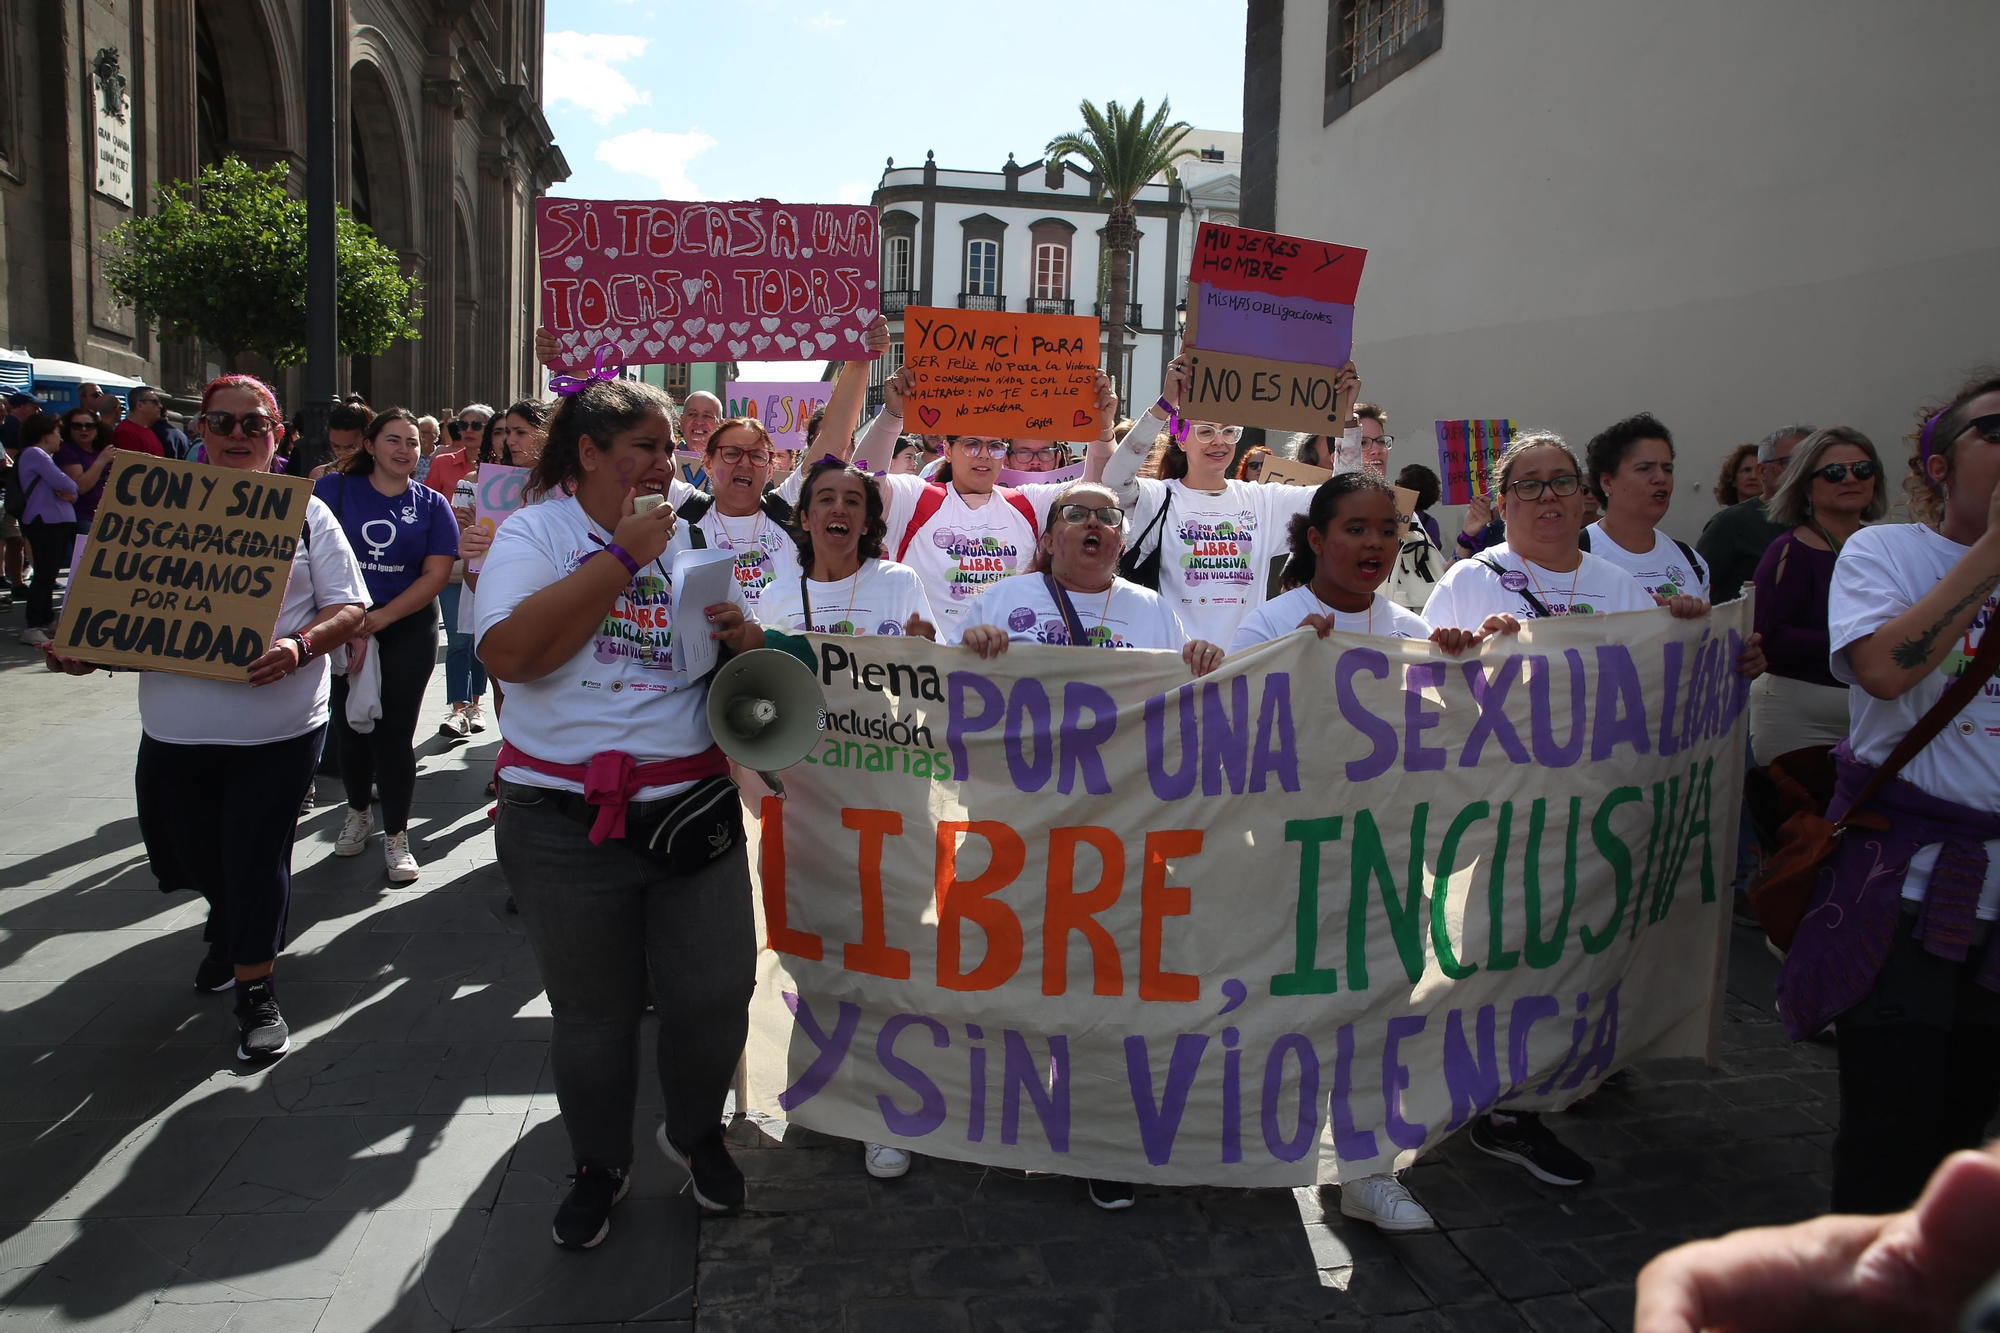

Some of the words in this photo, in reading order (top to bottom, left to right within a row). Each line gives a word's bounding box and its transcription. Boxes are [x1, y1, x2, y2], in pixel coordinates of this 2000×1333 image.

[110, 171, 121, 184] 1915
[614, 204, 766, 257] TOCAS
[772, 210, 798, 259] A
[813, 210, 874, 257] UNA
[1203, 254, 1288, 281] HOMBRE
[1313, 248, 1345, 273] Y
[544, 269, 682, 330] TOCAS
[702, 269, 723, 316] A
[734, 268, 860, 315] TODAS
[908, 355, 940, 370] SER
[985, 357, 1002, 372] NO
[978, 388, 993, 398] NO
[1000, 387, 1021, 399] TE
[1188, 357, 1241, 403] ¡NO
[1251, 372, 1281, 402] ES
[1290, 376, 1339, 422] NO!
[764, 395, 794, 434] ES
[956, 404, 969, 417] NO
[1441, 426, 1485, 440] QUEREMOS
[1443, 451, 1458, 463] POR
[115, 463, 193, 509] CON
[198, 476, 219, 511] Y
[226, 480, 293, 521] SIN
[96, 512, 297, 562] DISCAPACIDAD
[1215, 523, 1230, 531] UNA
[1193, 542, 1238, 556] LIBRE
[90, 548, 275, 598] LUCHAMOS
[368, 562, 377, 570] de
[959, 557, 1003, 571] LIBRE
[636, 576, 657, 589] UNA
[1185, 572, 1191, 580] Y
[1194, 572, 1209, 580] SIN
[1211, 571, 1254, 580] VIOLENCIAS
[130, 588, 179, 611] POR
[184, 596, 212, 613] LA
[951, 586, 957, 594] Y
[68, 606, 263, 667] IGUALDAD
[829, 624, 847, 633] UNA
[596, 641, 606, 653] Y
[609, 642, 628, 657] SIN
[821, 643, 945, 703] Plena
[946, 671, 1117, 795] POR
[1144, 671, 1301, 801] UNA
[1270, 756, 1717, 996] INCLUSIVA
[778, 992, 858, 1112] Y
